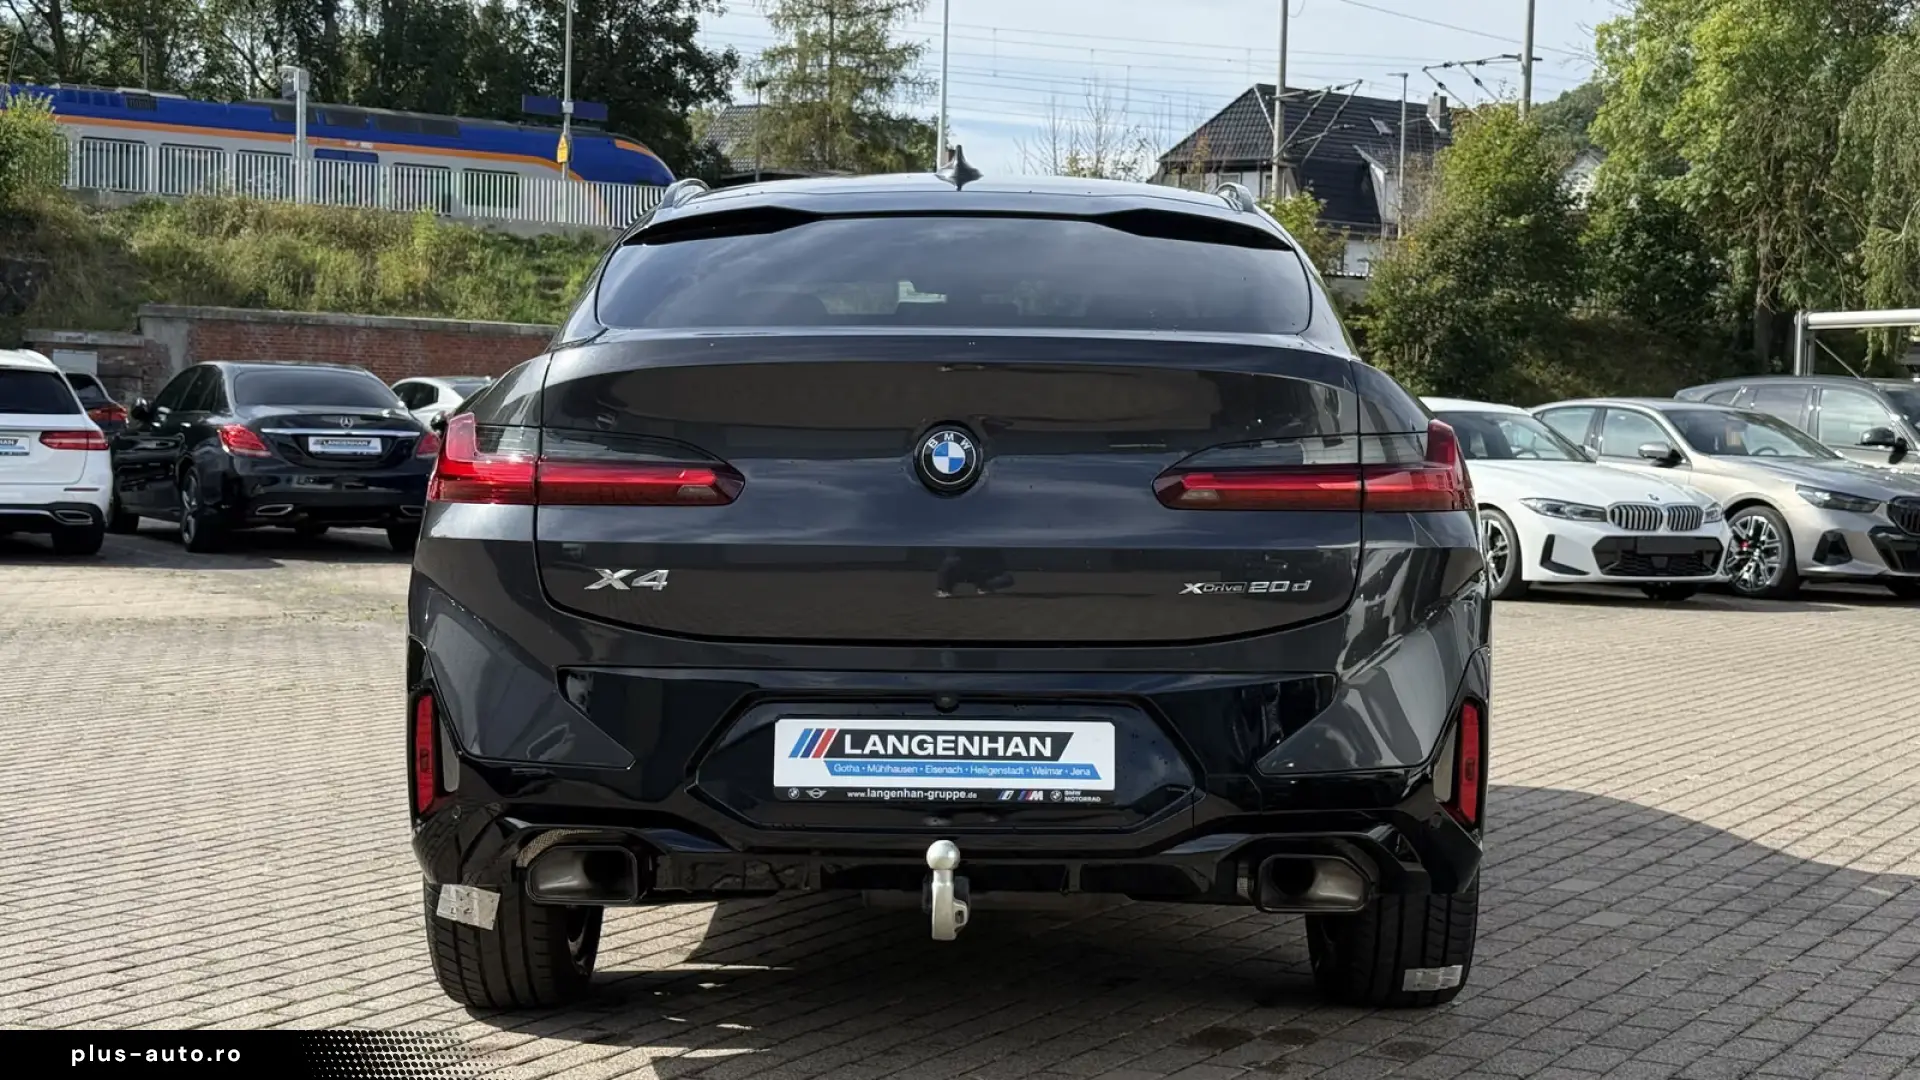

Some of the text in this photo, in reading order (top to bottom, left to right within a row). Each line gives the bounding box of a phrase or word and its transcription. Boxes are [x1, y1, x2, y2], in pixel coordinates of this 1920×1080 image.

[928, 433, 972, 450] BMW
[584, 568, 669, 591] X4
[844, 734, 1052, 757] LANGENHAN
[833, 763, 1091, 777] Gotha Mühlhausen Eisenach Heiligenstadt Weimar Jena
[847, 788, 978, 800] www.langenhan-gruppe.de
